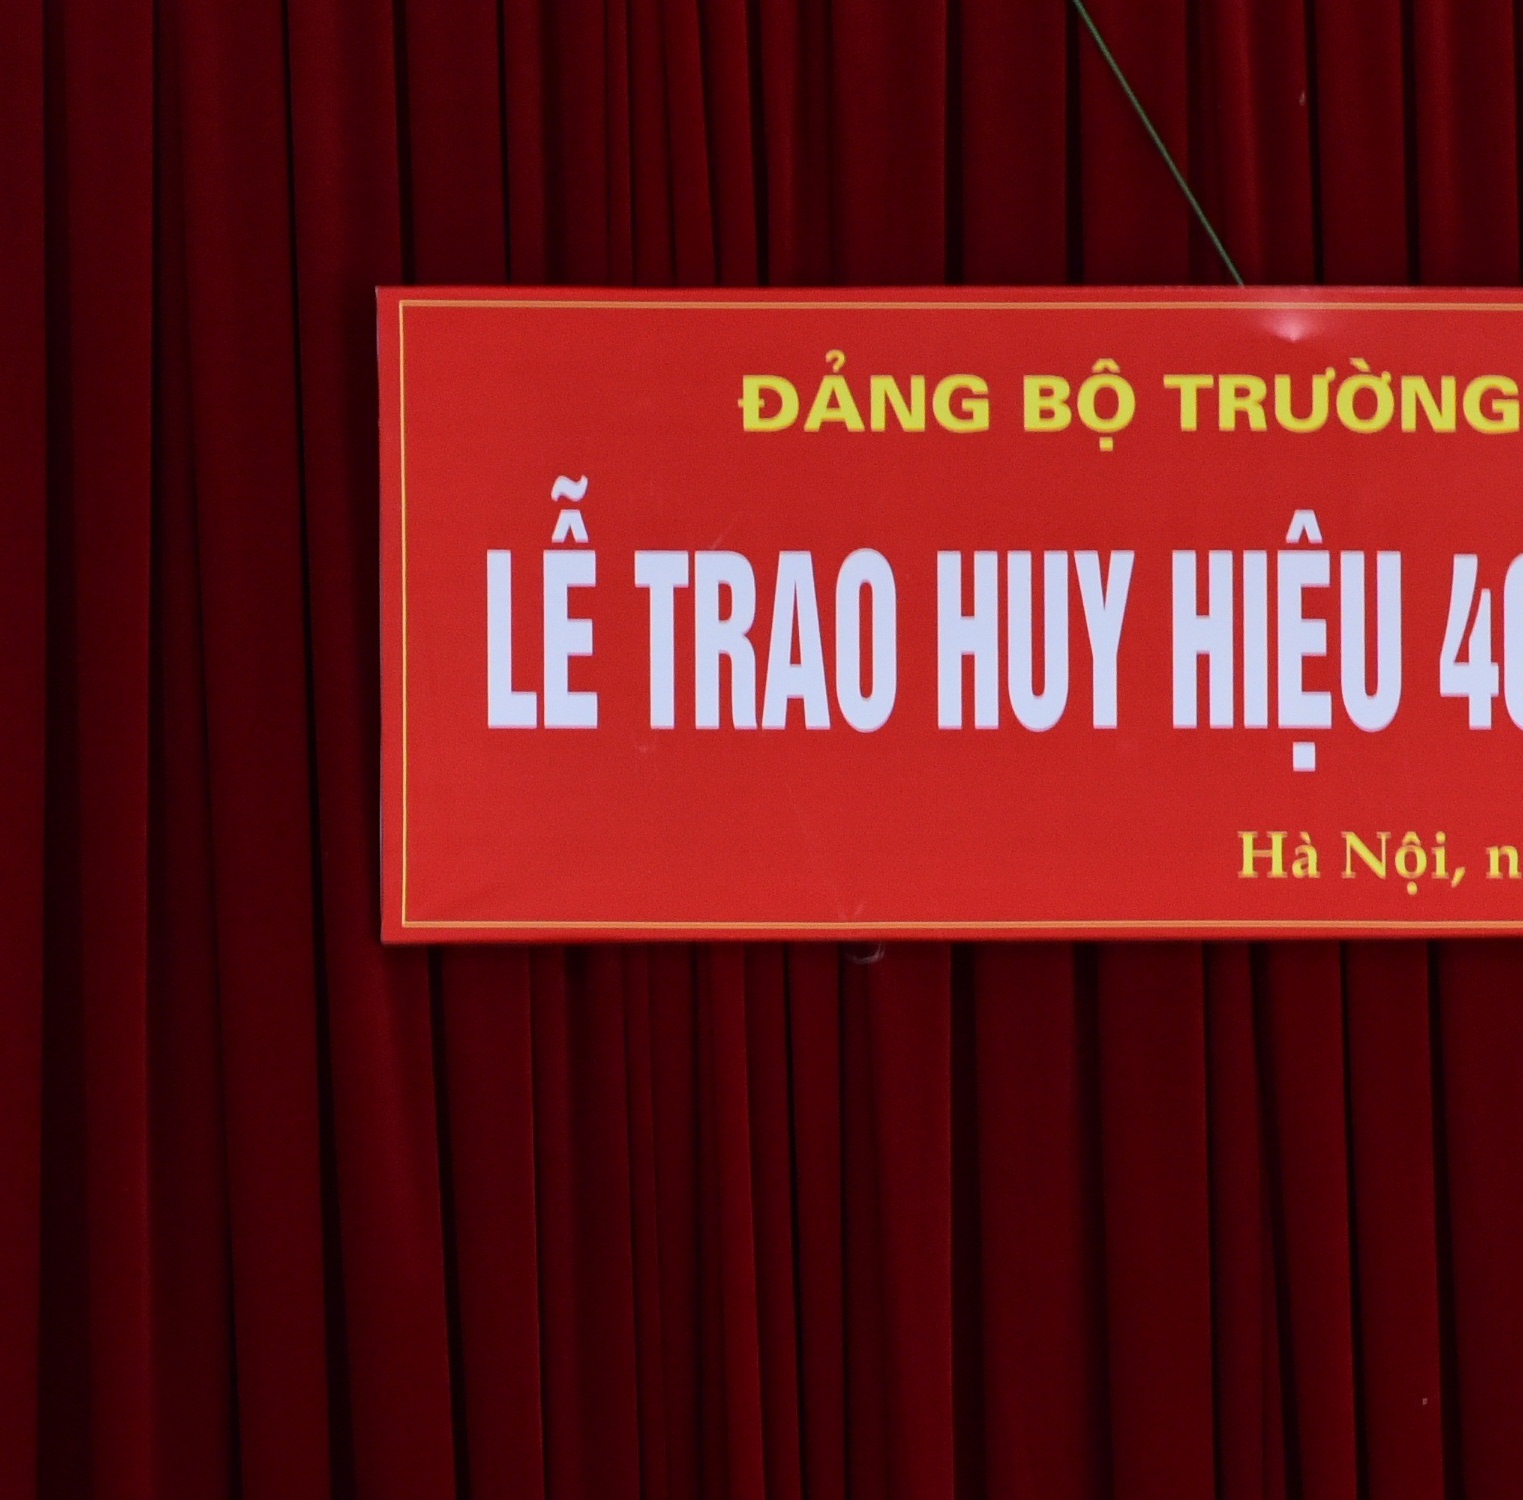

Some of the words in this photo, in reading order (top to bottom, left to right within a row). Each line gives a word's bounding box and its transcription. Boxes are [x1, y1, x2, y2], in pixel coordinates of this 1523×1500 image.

[739, 350, 989, 433] ĐẢNG
[1024, 359, 1135, 451] BỘ
[1164, 358, 1519, 434] TRƯỜNG
[487, 476, 597, 729] LỄ
[635, 549, 896, 732] TRAO
[937, 551, 1134, 732] HUY
[1173, 510, 1401, 771] HIỆU
[1239, 831, 1319, 879] Hà
[1342, 831, 1465, 894] Nội,
